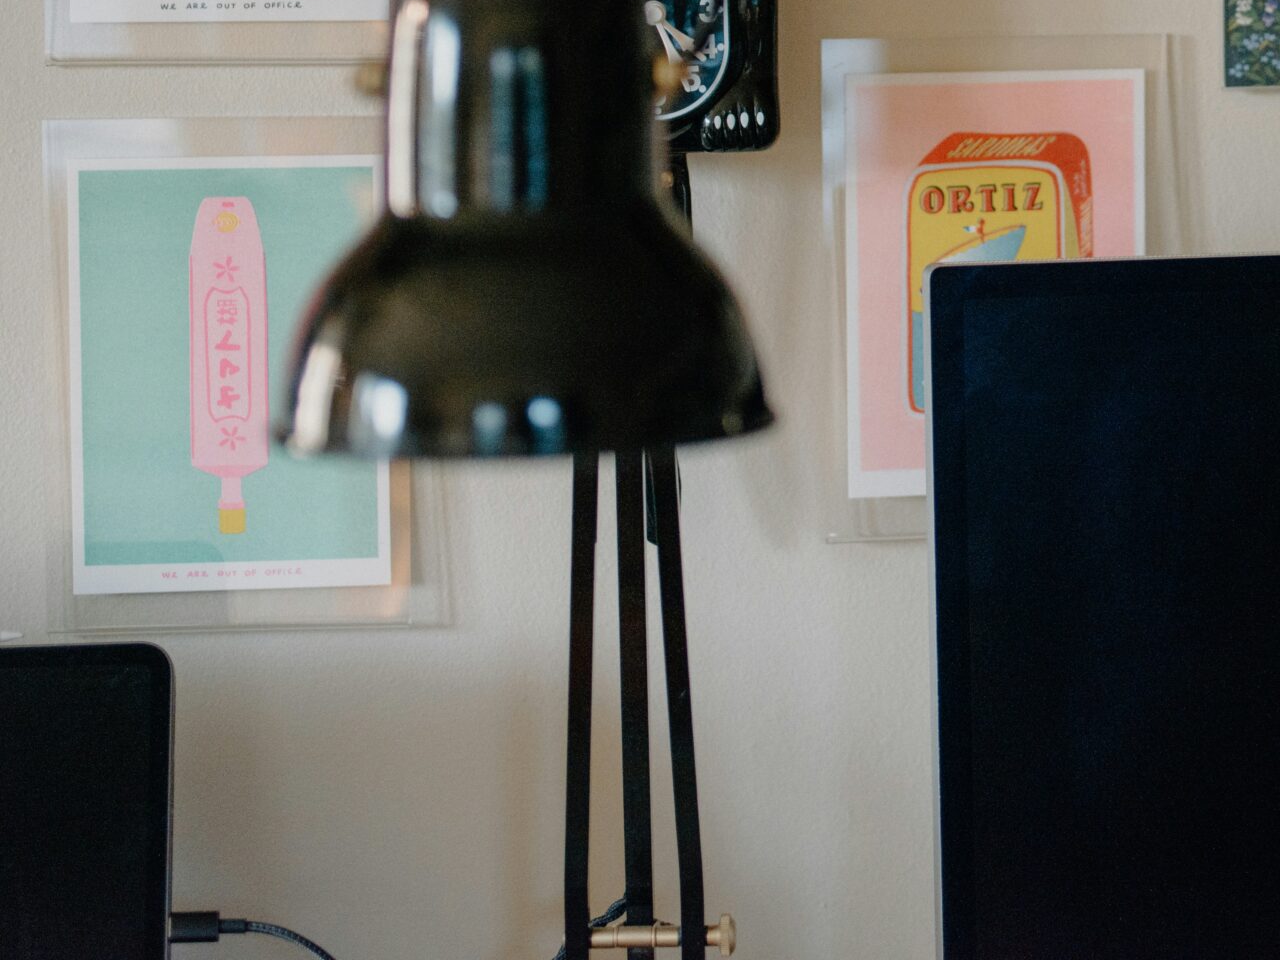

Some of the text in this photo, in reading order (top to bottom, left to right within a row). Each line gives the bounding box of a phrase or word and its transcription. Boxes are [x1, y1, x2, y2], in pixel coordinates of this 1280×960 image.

[216, 2, 237, 10] OUT
[243, 1, 257, 10] OF
[702, 33, 718, 59] 4
[681, 65, 701, 93] 5
[920, 181, 1043, 214] ORTIZ
